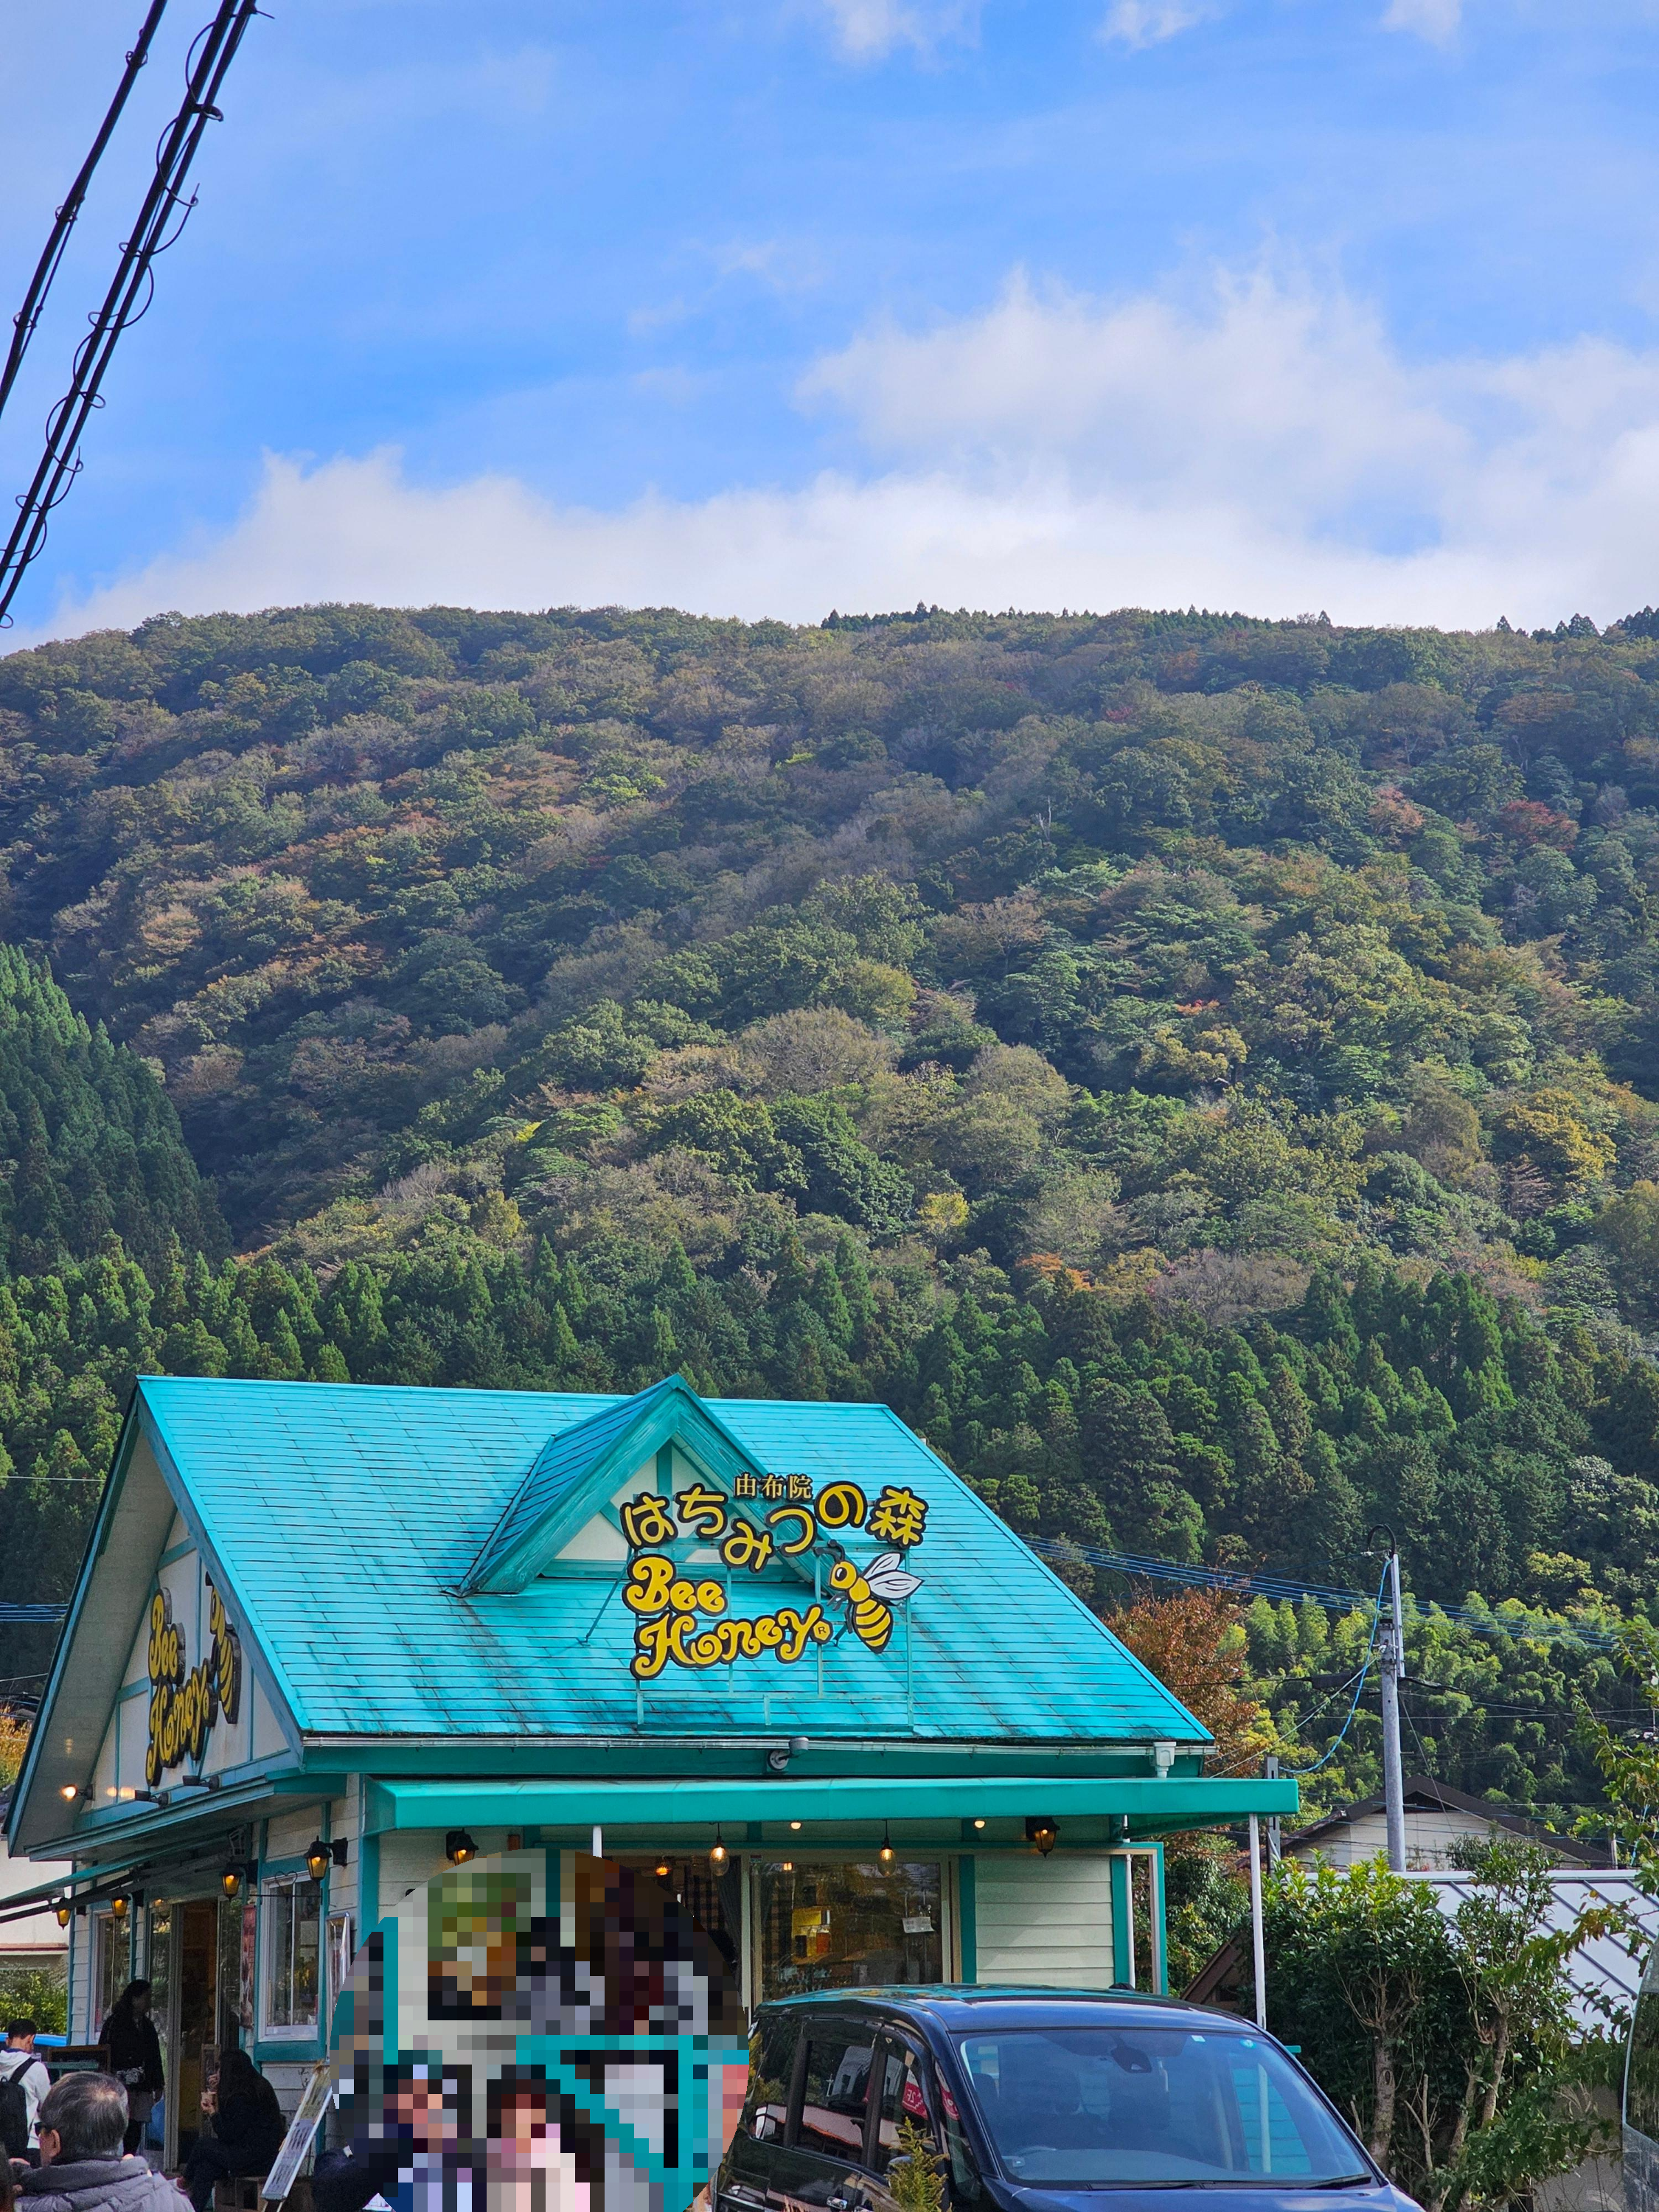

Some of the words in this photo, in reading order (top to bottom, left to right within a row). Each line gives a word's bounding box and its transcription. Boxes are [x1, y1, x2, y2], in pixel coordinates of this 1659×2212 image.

[735, 1473, 812, 1499] 由布院
[622, 1483, 926, 1571] はちみつの森
[624, 1555, 726, 1613] Bee
[149, 1590, 179, 1682] Bee
[633, 1604, 822, 1677] Honey
[146, 1662, 209, 1784] Honey
